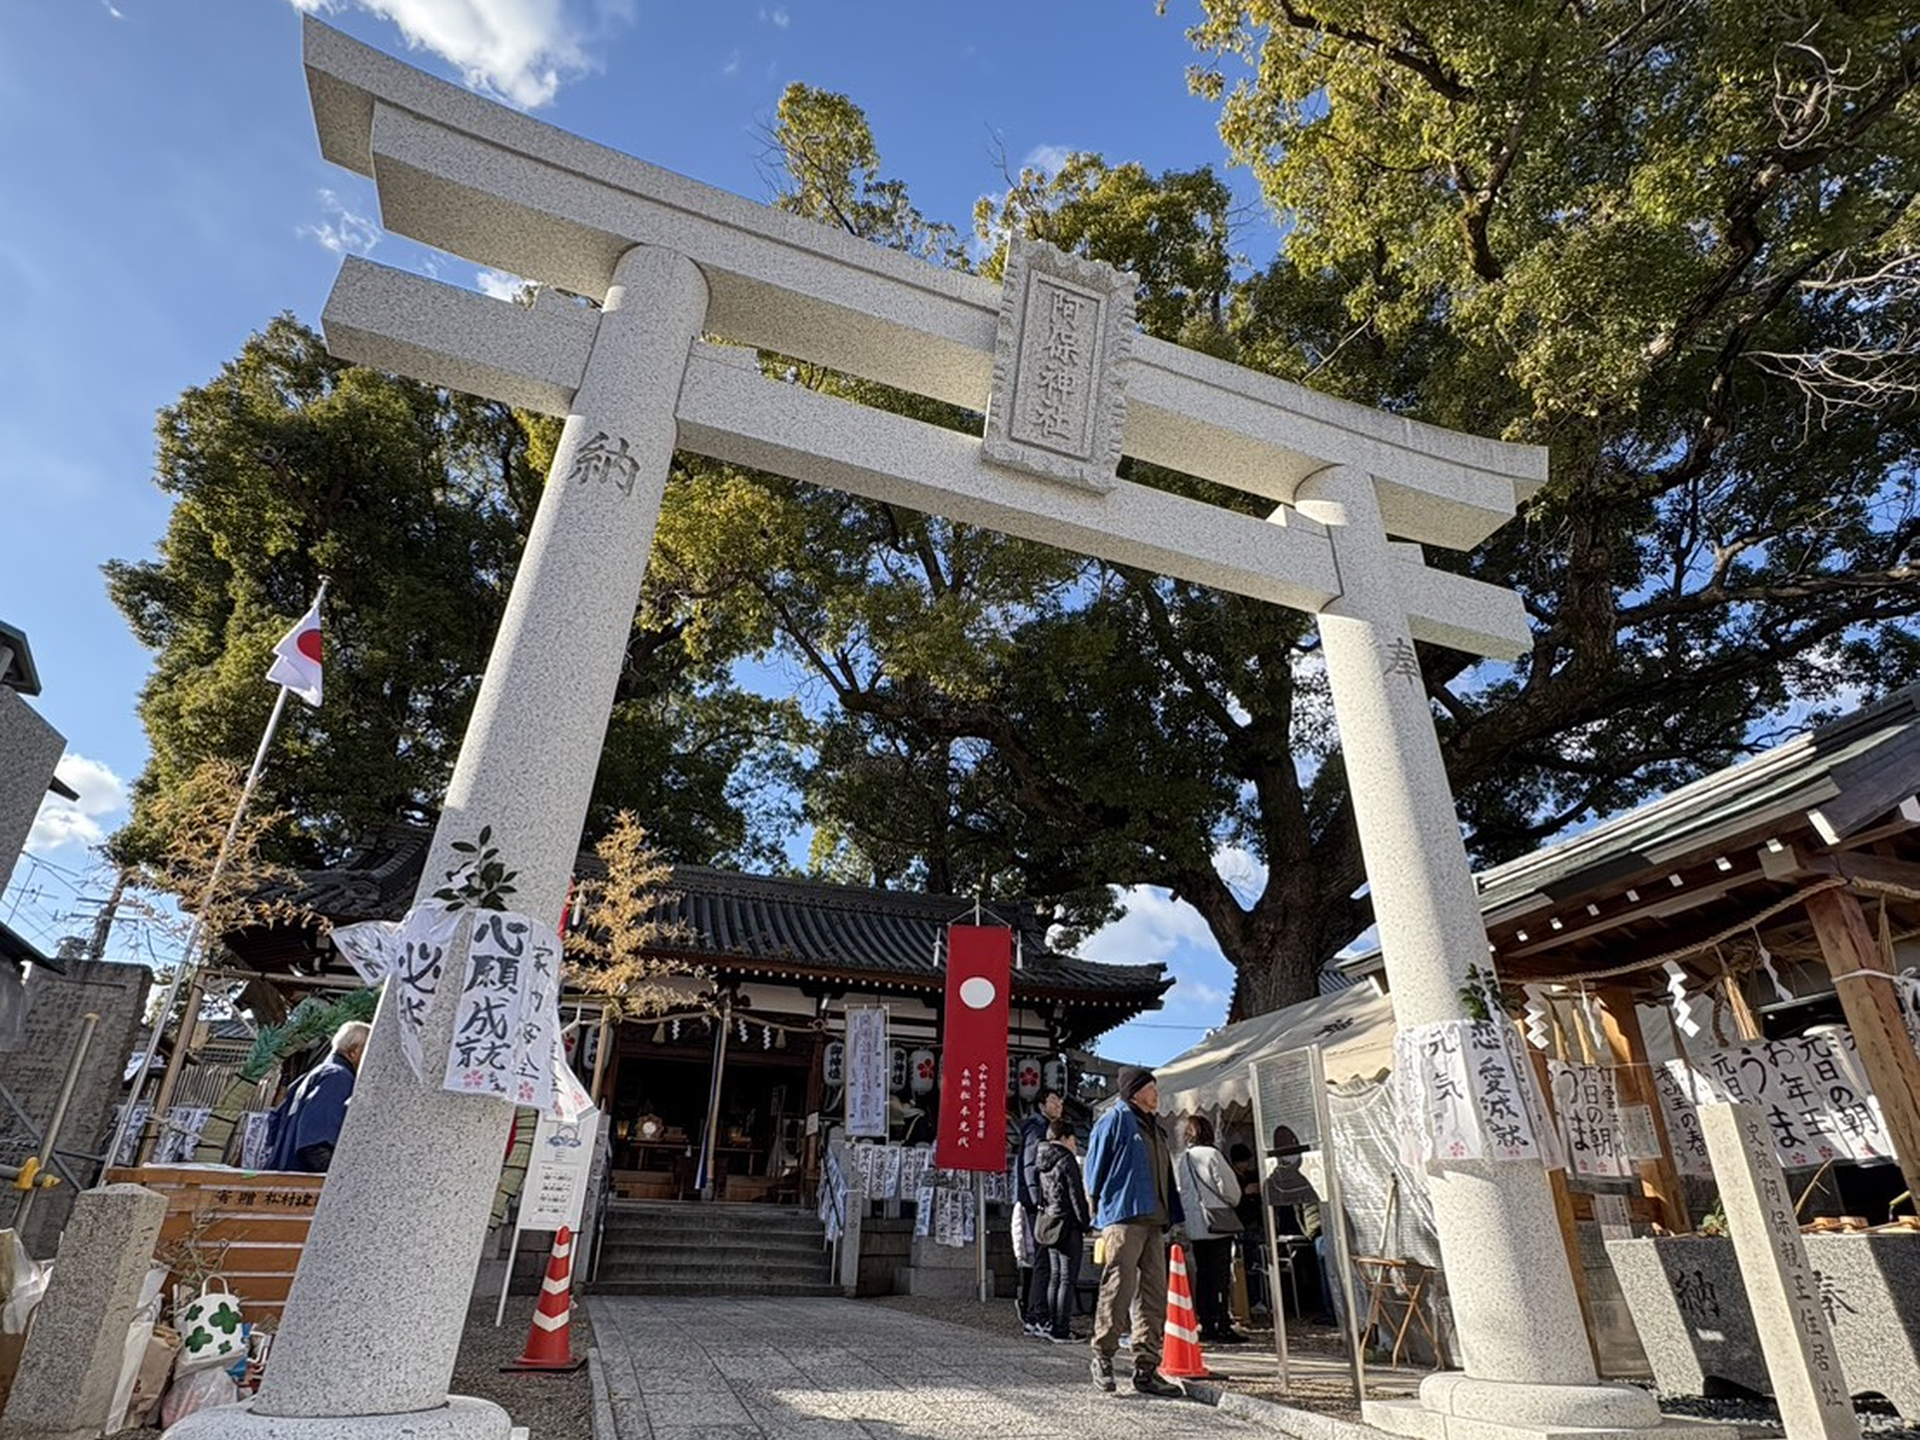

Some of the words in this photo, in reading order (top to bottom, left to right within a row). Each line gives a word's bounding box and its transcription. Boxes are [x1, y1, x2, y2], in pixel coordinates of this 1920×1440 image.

[1031, 293, 1084, 441] 阿保神社
[566, 431, 641, 498] 納
[1383, 637, 1419, 686] 奉
[454, 914, 529, 1072] 心願成就
[1429, 1030, 1465, 1102] 元気
[1470, 1023, 1529, 1148] 恋愛成就
[1711, 1052, 1753, 1104] 元日
[1740, 1046, 1807, 1149] うま
[1799, 1035, 1880, 1139] 元日の朝
[1579, 1066, 1613, 1158] 元日の朝
[265, 1191, 320, 1207] 松村建
[1674, 1269, 1721, 1317] 納
